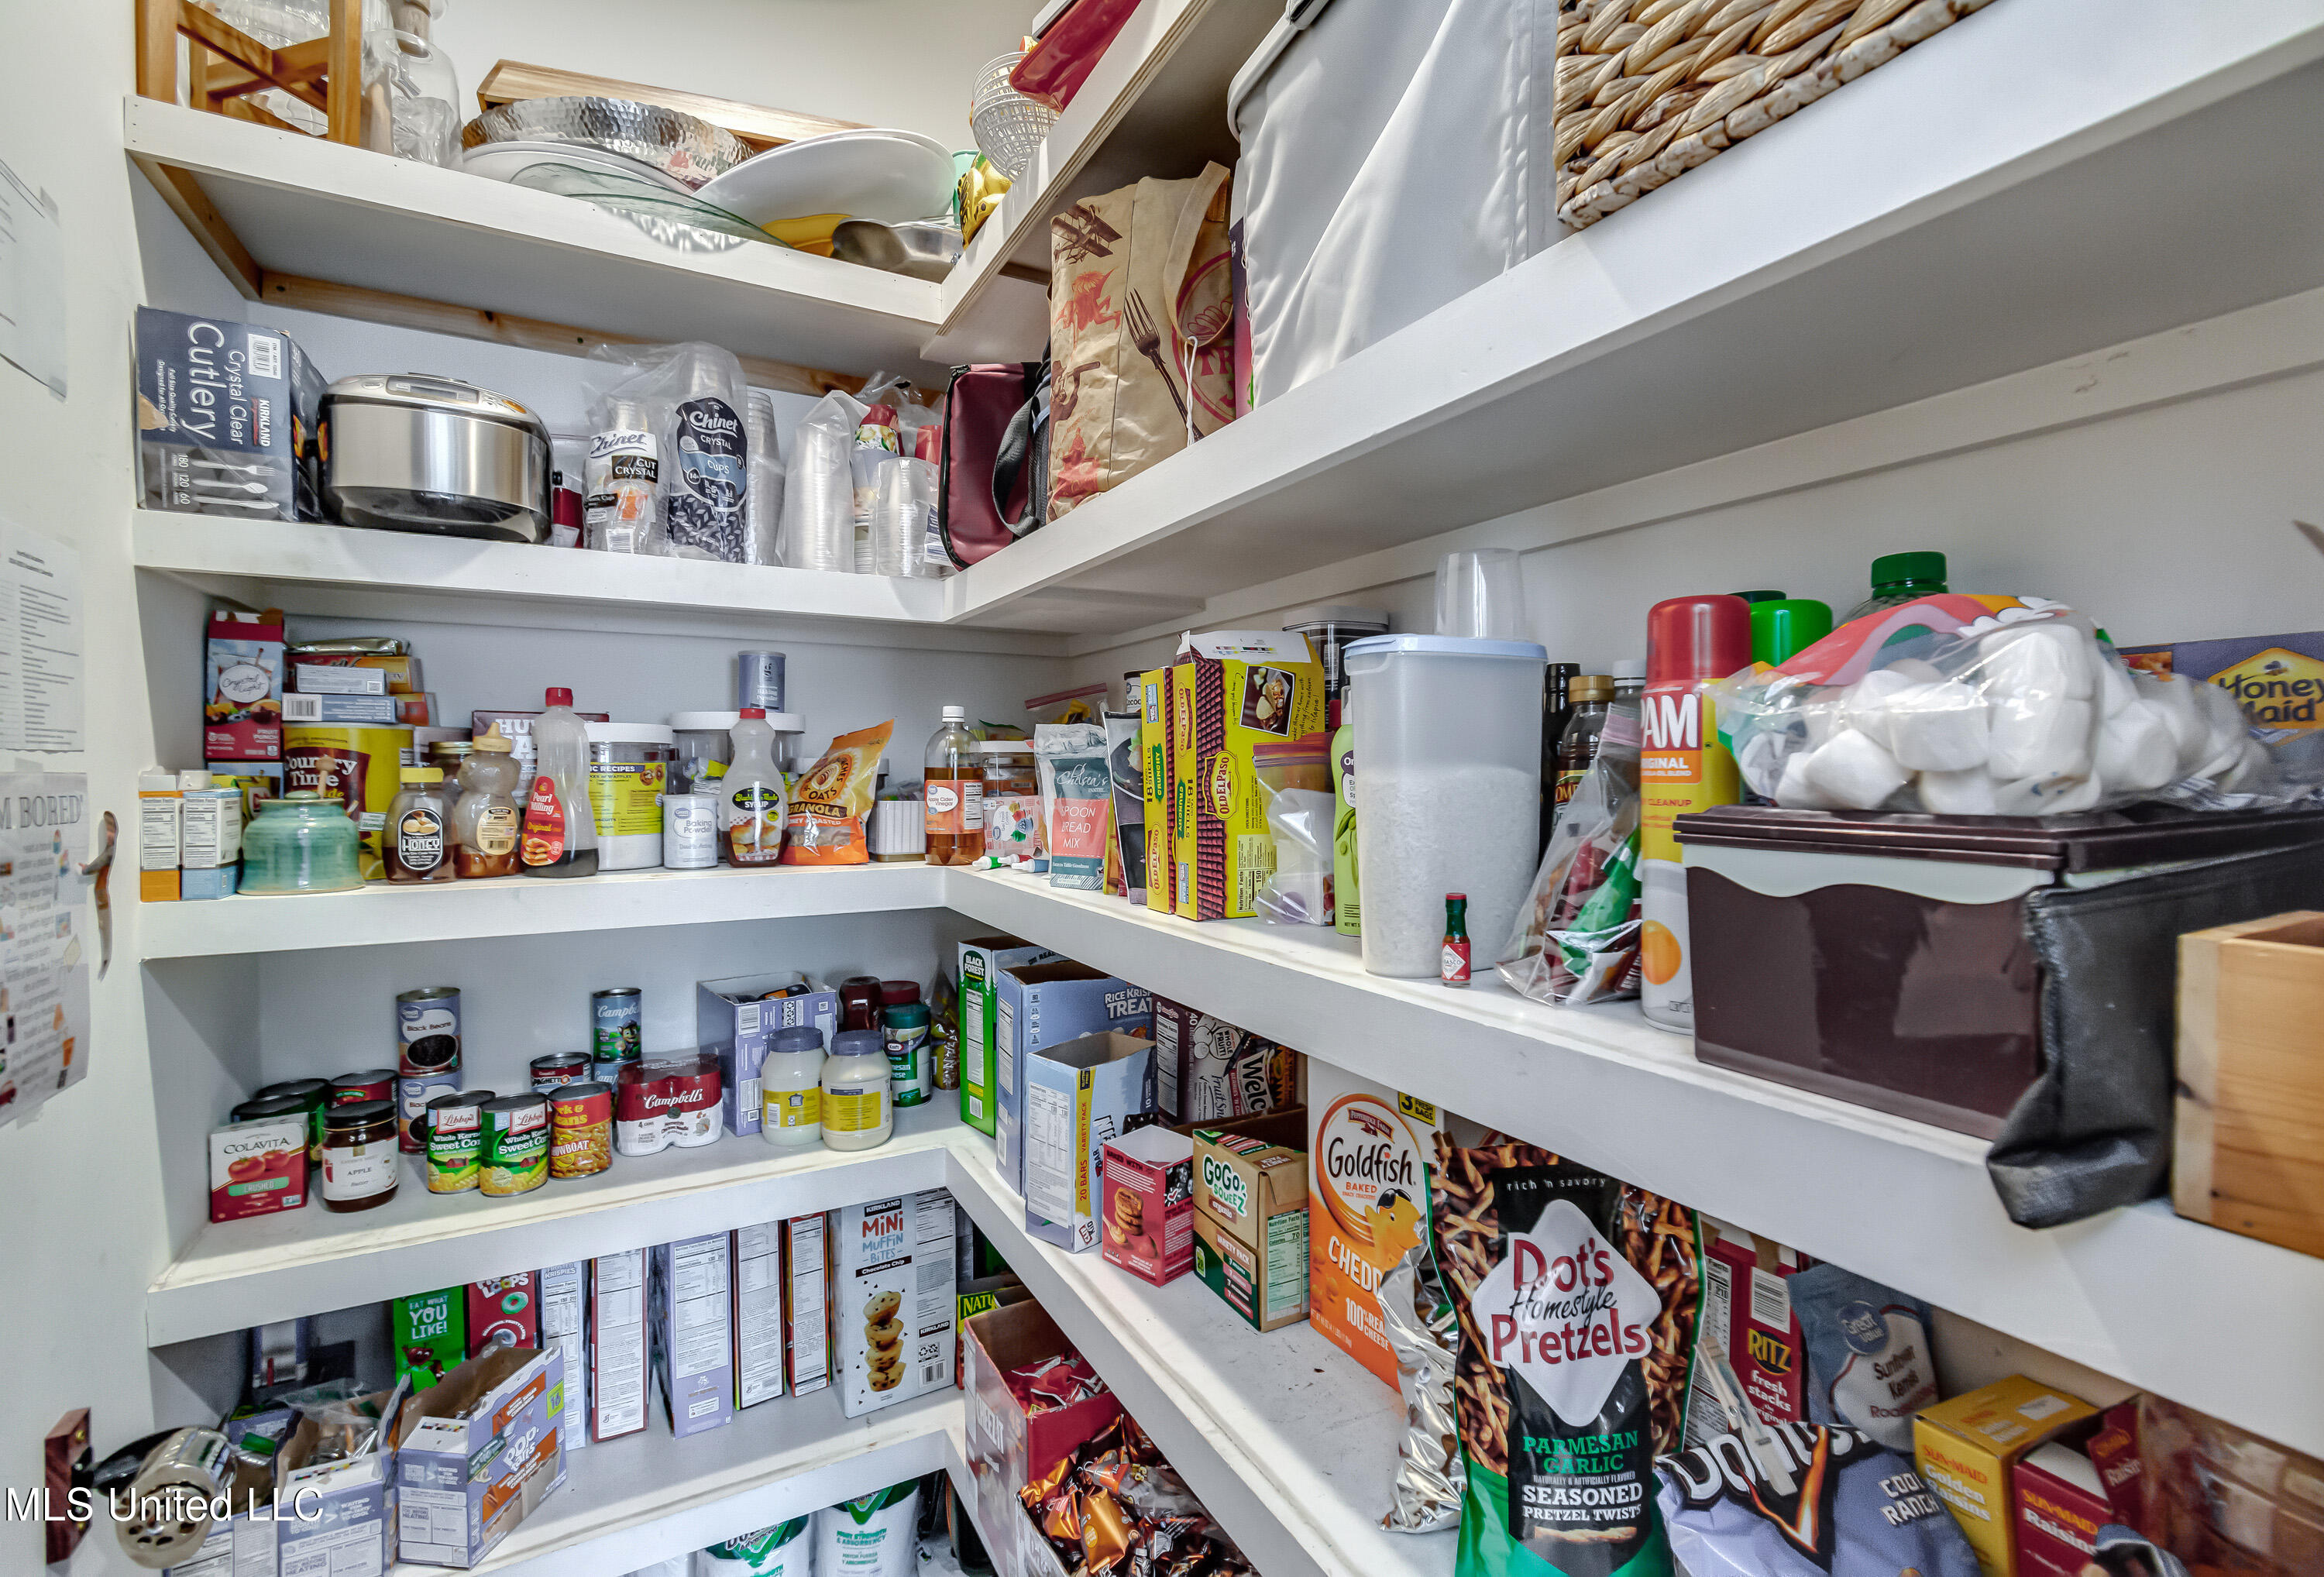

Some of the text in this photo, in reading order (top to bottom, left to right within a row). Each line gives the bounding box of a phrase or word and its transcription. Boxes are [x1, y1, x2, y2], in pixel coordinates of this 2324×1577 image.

[180, 321, 227, 440] Cutlery
[224, 349, 248, 445] Crystal Clear
[260, 398, 271, 447] KIRKLAND
[689, 411, 738, 432] Chinet
[590, 433, 647, 455] Chinet
[700, 435, 732, 450] CRYSTAL
[637, 459, 657, 469] CUT
[707, 460, 730, 474] CUPS
[178, 454, 191, 504] 180 120 60
[614, 466, 657, 479] CRYSTAL
[1057, 763, 1109, 786] Chelsea's
[808, 786, 837, 800] OATS
[1216, 757, 1230, 814] OLD EL PASO
[533, 792, 552, 802] Pearl
[530, 801, 555, 816] Milling
[788, 803, 841, 817] GRANOLA
[1061, 806, 1096, 817] SPOON
[683, 825, 713, 834] Powder
[686, 819, 713, 829] Baking
[1061, 821, 1092, 834] BREAD
[1063, 838, 1081, 849] MIX
[965, 954, 983, 967] BLACK
[964, 964, 985, 976] FOREST
[1105, 990, 1126, 1005] RICE
[429, 1022, 451, 1030] Beans
[1216, 1032, 1226, 1056] FRUIT
[1225, 1030, 1233, 1054] WHOLE
[644, 1088, 703, 1109] Campbell's
[1401, 1095, 1413, 1111] 3
[444, 1114, 475, 1126] Libby's
[517, 1111, 543, 1127] Libby's
[555, 1115, 588, 1126] eans
[1415, 1108, 1433, 1120] BAGS
[433, 1133, 456, 1142] Whole
[504, 1134, 531, 1145] Whole
[224, 1137, 291, 1155] COLAVITA
[430, 1140, 460, 1151] Sweet
[498, 1140, 535, 1155] Sweet
[1328, 1136, 1413, 1186] Goldfish
[347, 1166, 372, 1177] APPLE
[243, 1180, 275, 1193] CRUSHED
[1346, 1181, 1377, 1194] BAKED
[1507, 1177, 1606, 1191] rich savory
[1081, 1190, 1088, 1201] 20
[865, 1201, 901, 1214] KIRKLAND
[1217, 1235, 1250, 1265] VARIETY PACK
[861, 1259, 905, 1275] Chocolate Chip
[1514, 1237, 1614, 1293] Dot's
[545, 1267, 576, 1280] KRISPIES
[482, 1272, 529, 1299] LOOPS
[409, 1301, 425, 1311] EAT
[1509, 1285, 1618, 1328] Homestyle
[409, 1304, 448, 1326] YOU
[411, 1320, 448, 1340] LIKE!
[920, 1321, 950, 1335] KIRKLAND
[1364, 1326, 1389, 1352] CHEESE
[1491, 1307, 1647, 1365] Pretzels
[1748, 1328, 1792, 1373] RITZ
[1751, 1369, 1788, 1397] fresh
[550, 1393, 562, 1410] 16
[1748, 1385, 1792, 1412] stacks
[1522, 1431, 1638, 1455] PARMESAN
[1543, 1454, 1624, 1475] GARLIC
[1533, 1474, 1566, 1486] NATURALLY
[1611, 1471, 1636, 1483] FLAVORED
[1924, 1464, 1985, 1505] Golden
[1522, 1483, 1643, 1507] SEASONED
[1522, 1503, 1642, 1521] PRETZEL TWISTS
[1881, 1493, 1939, 1526] RANCH
